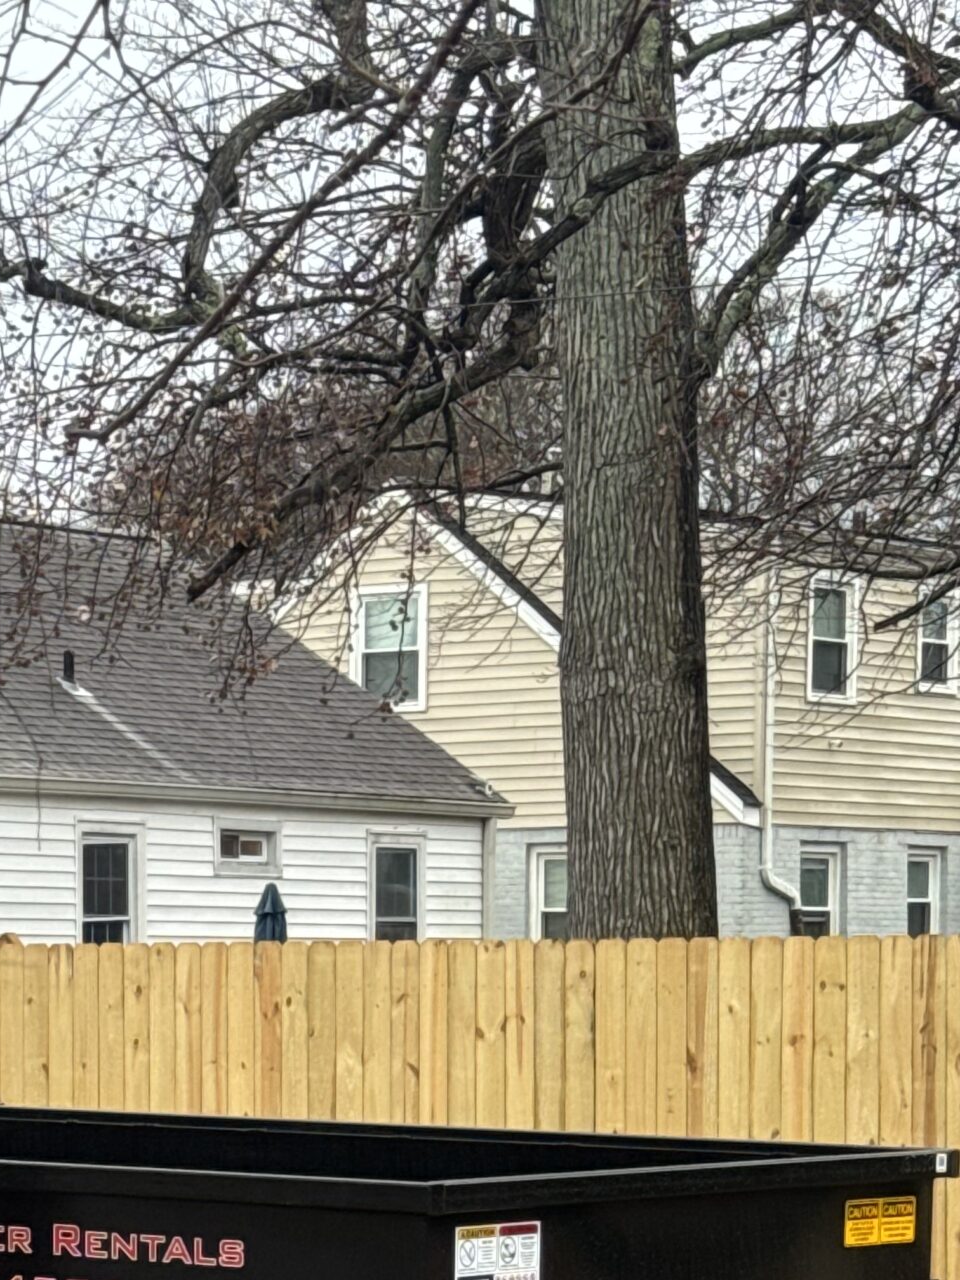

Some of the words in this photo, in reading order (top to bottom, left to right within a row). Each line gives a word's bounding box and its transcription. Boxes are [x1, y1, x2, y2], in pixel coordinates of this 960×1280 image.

[848, 1206, 878, 1218] CAUTION
[883, 1203, 913, 1216] CAUTION
[52, 1222, 245, 1269] RENTALS
